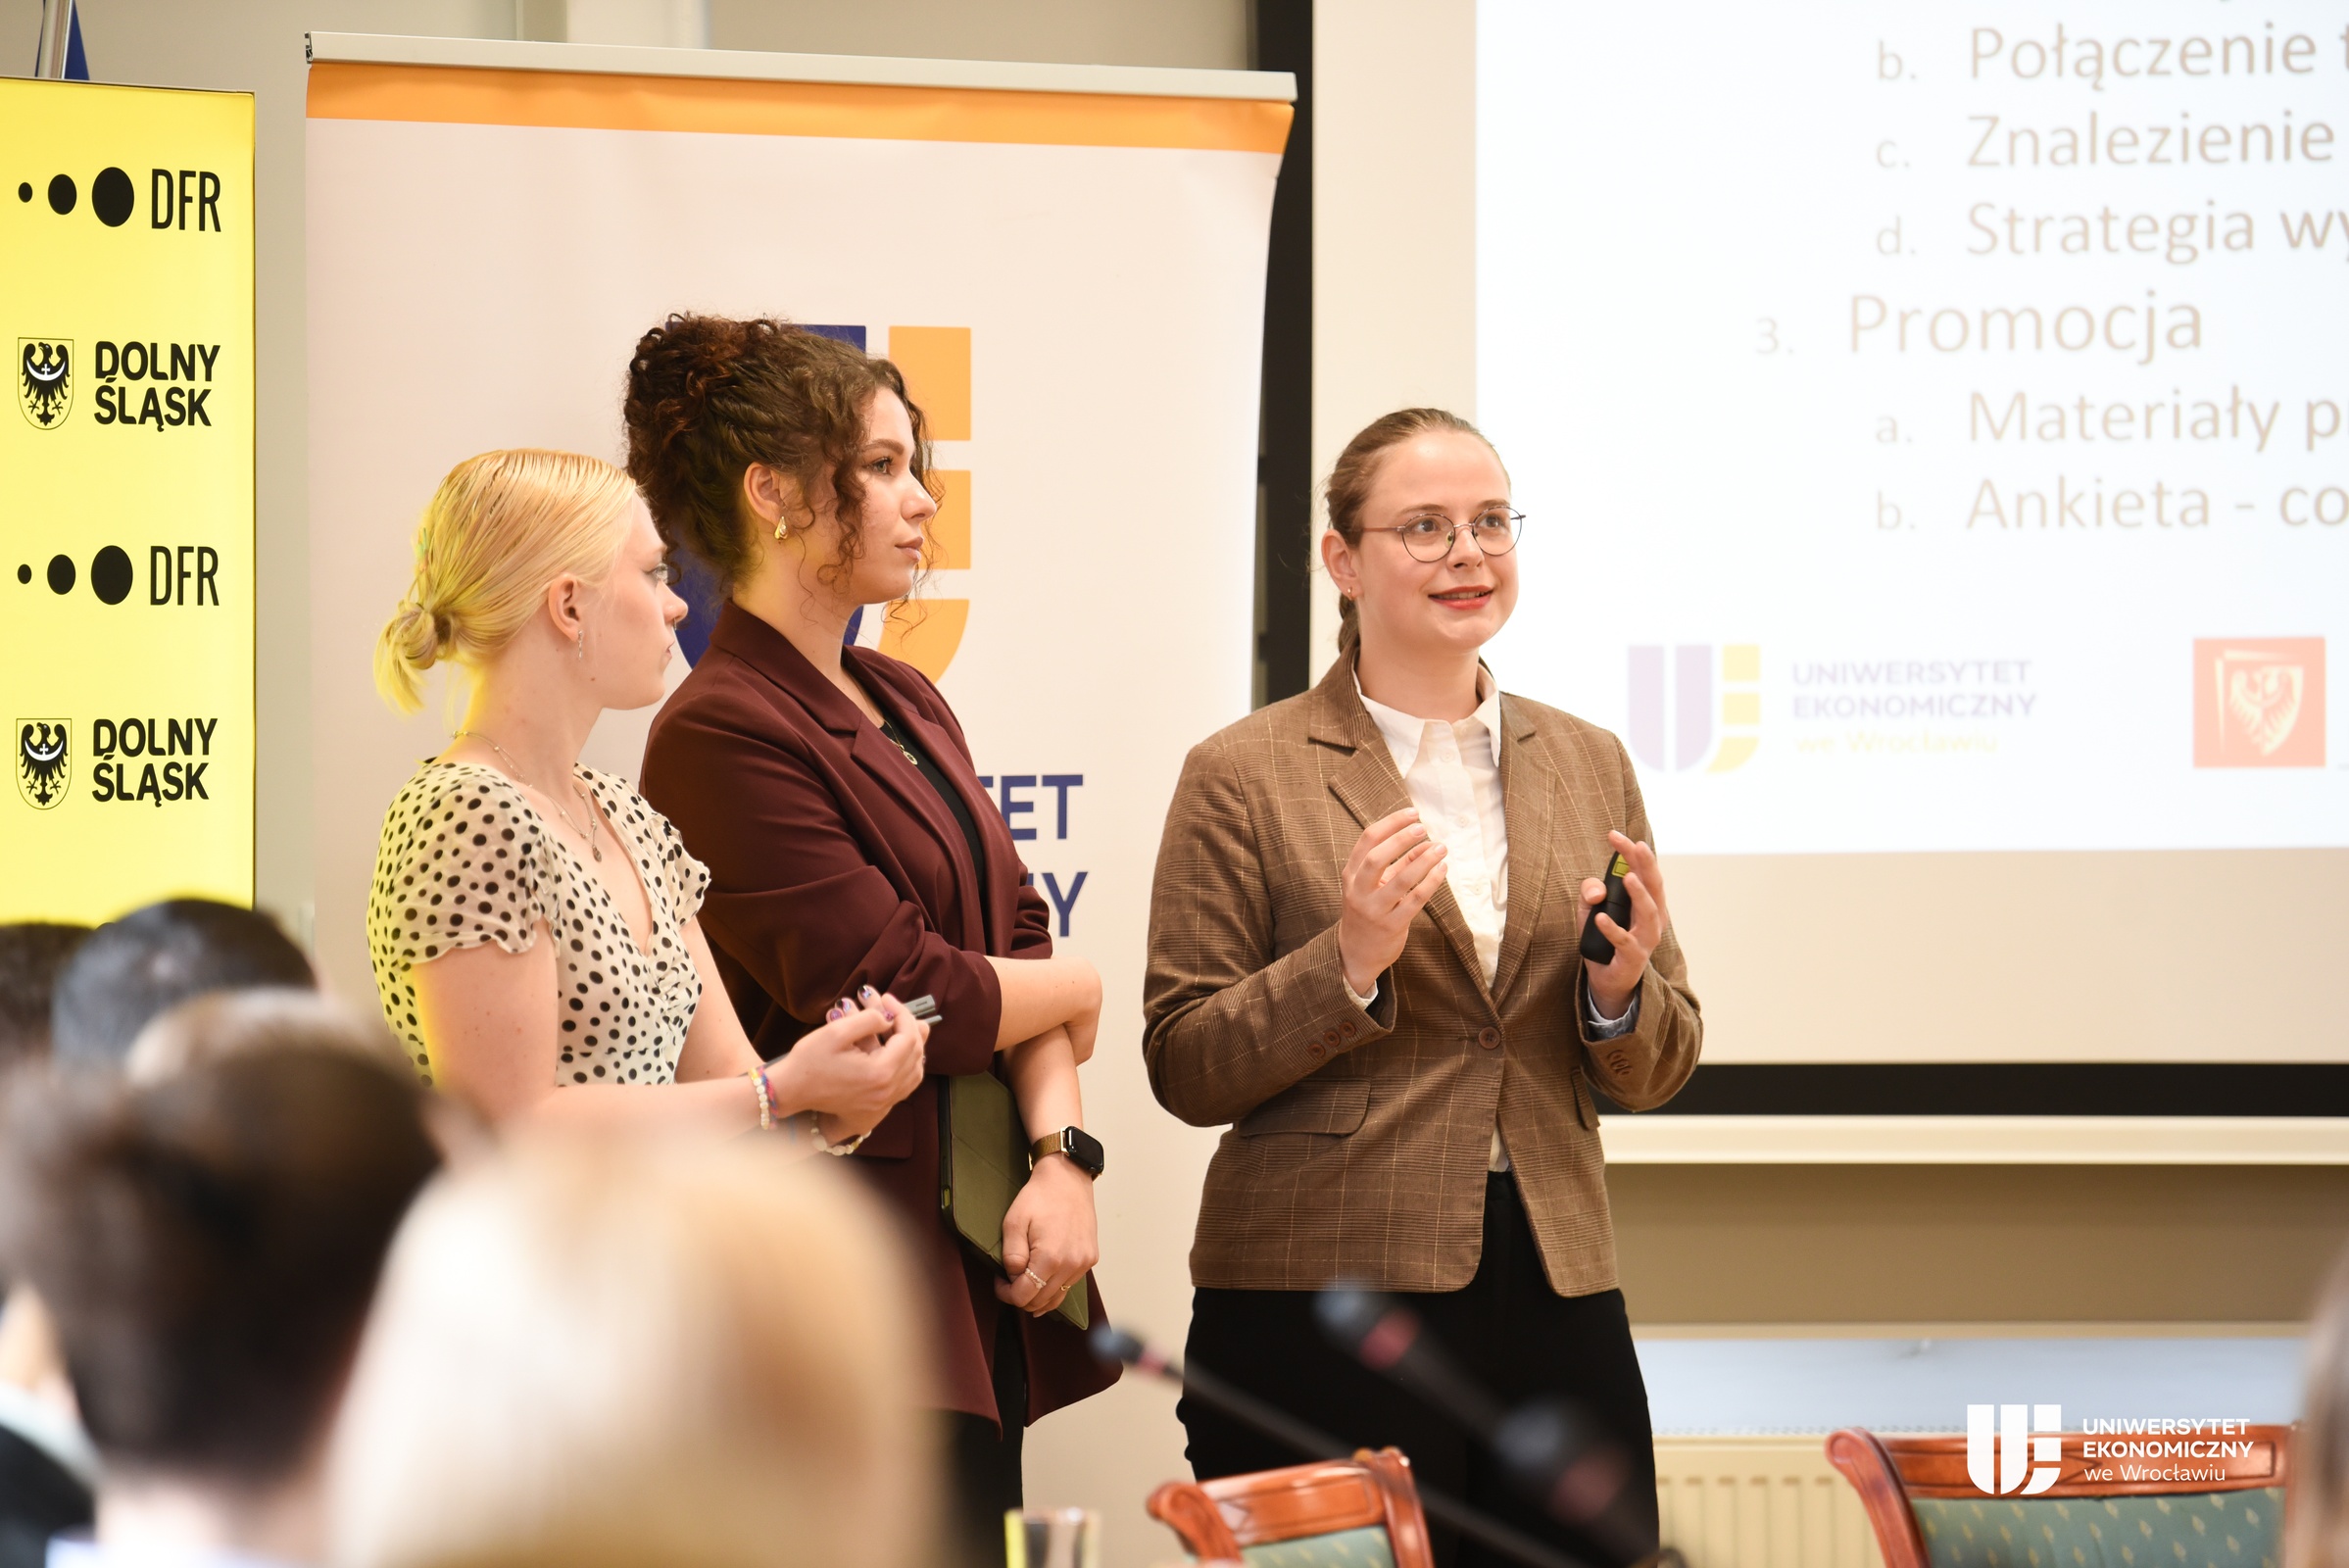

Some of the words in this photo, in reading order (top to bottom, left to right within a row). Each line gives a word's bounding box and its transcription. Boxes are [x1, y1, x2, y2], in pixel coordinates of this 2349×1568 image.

[1877, 39, 1918, 81] b.
[1971, 22, 2318, 92] Połączenie
[1876, 139, 1911, 169] c.
[1967, 110, 2335, 168] Znalezienie
[150, 169, 221, 232] DFR
[1876, 215, 1917, 256] d.
[1967, 198, 2255, 266] Strategia
[1755, 317, 1794, 355] 3.
[1851, 288, 2203, 367] Promocja
[95, 340, 221, 382] DOLNY
[93, 376, 213, 433] ŚLĄSK
[1875, 415, 1913, 444] a.
[1970, 383, 2281, 453] Materiały
[2306, 399, 2349, 453] p
[1877, 489, 1917, 530] b.
[1967, 473, 2211, 530] Ankieta
[149, 545, 220, 607] DFR
[1791, 660, 2032, 687] UNIWERSYTET
[1792, 692, 2037, 720] EKONOMICZNY
[93, 718, 218, 757] DOLNY
[92, 754, 210, 808] ŚLĄSK
[978, 774, 1083, 840] ET
